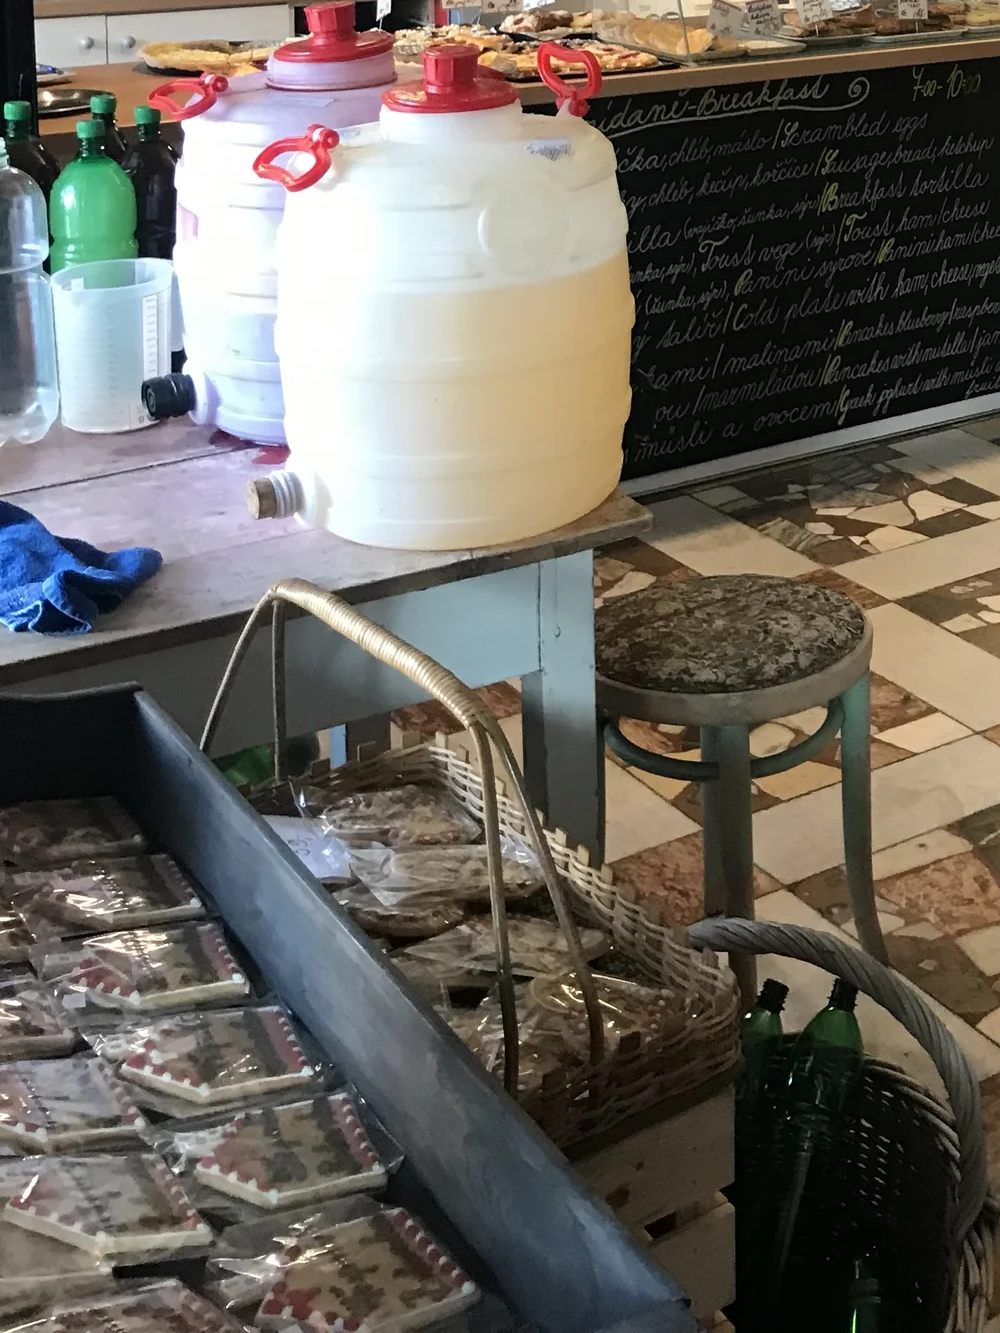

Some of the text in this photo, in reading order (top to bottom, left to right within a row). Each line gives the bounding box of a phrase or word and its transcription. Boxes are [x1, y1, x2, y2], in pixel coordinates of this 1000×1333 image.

[892, 113, 928, 142] eggs
[909, 163, 990, 197] tortilla
[722, 422, 744, 438] a
